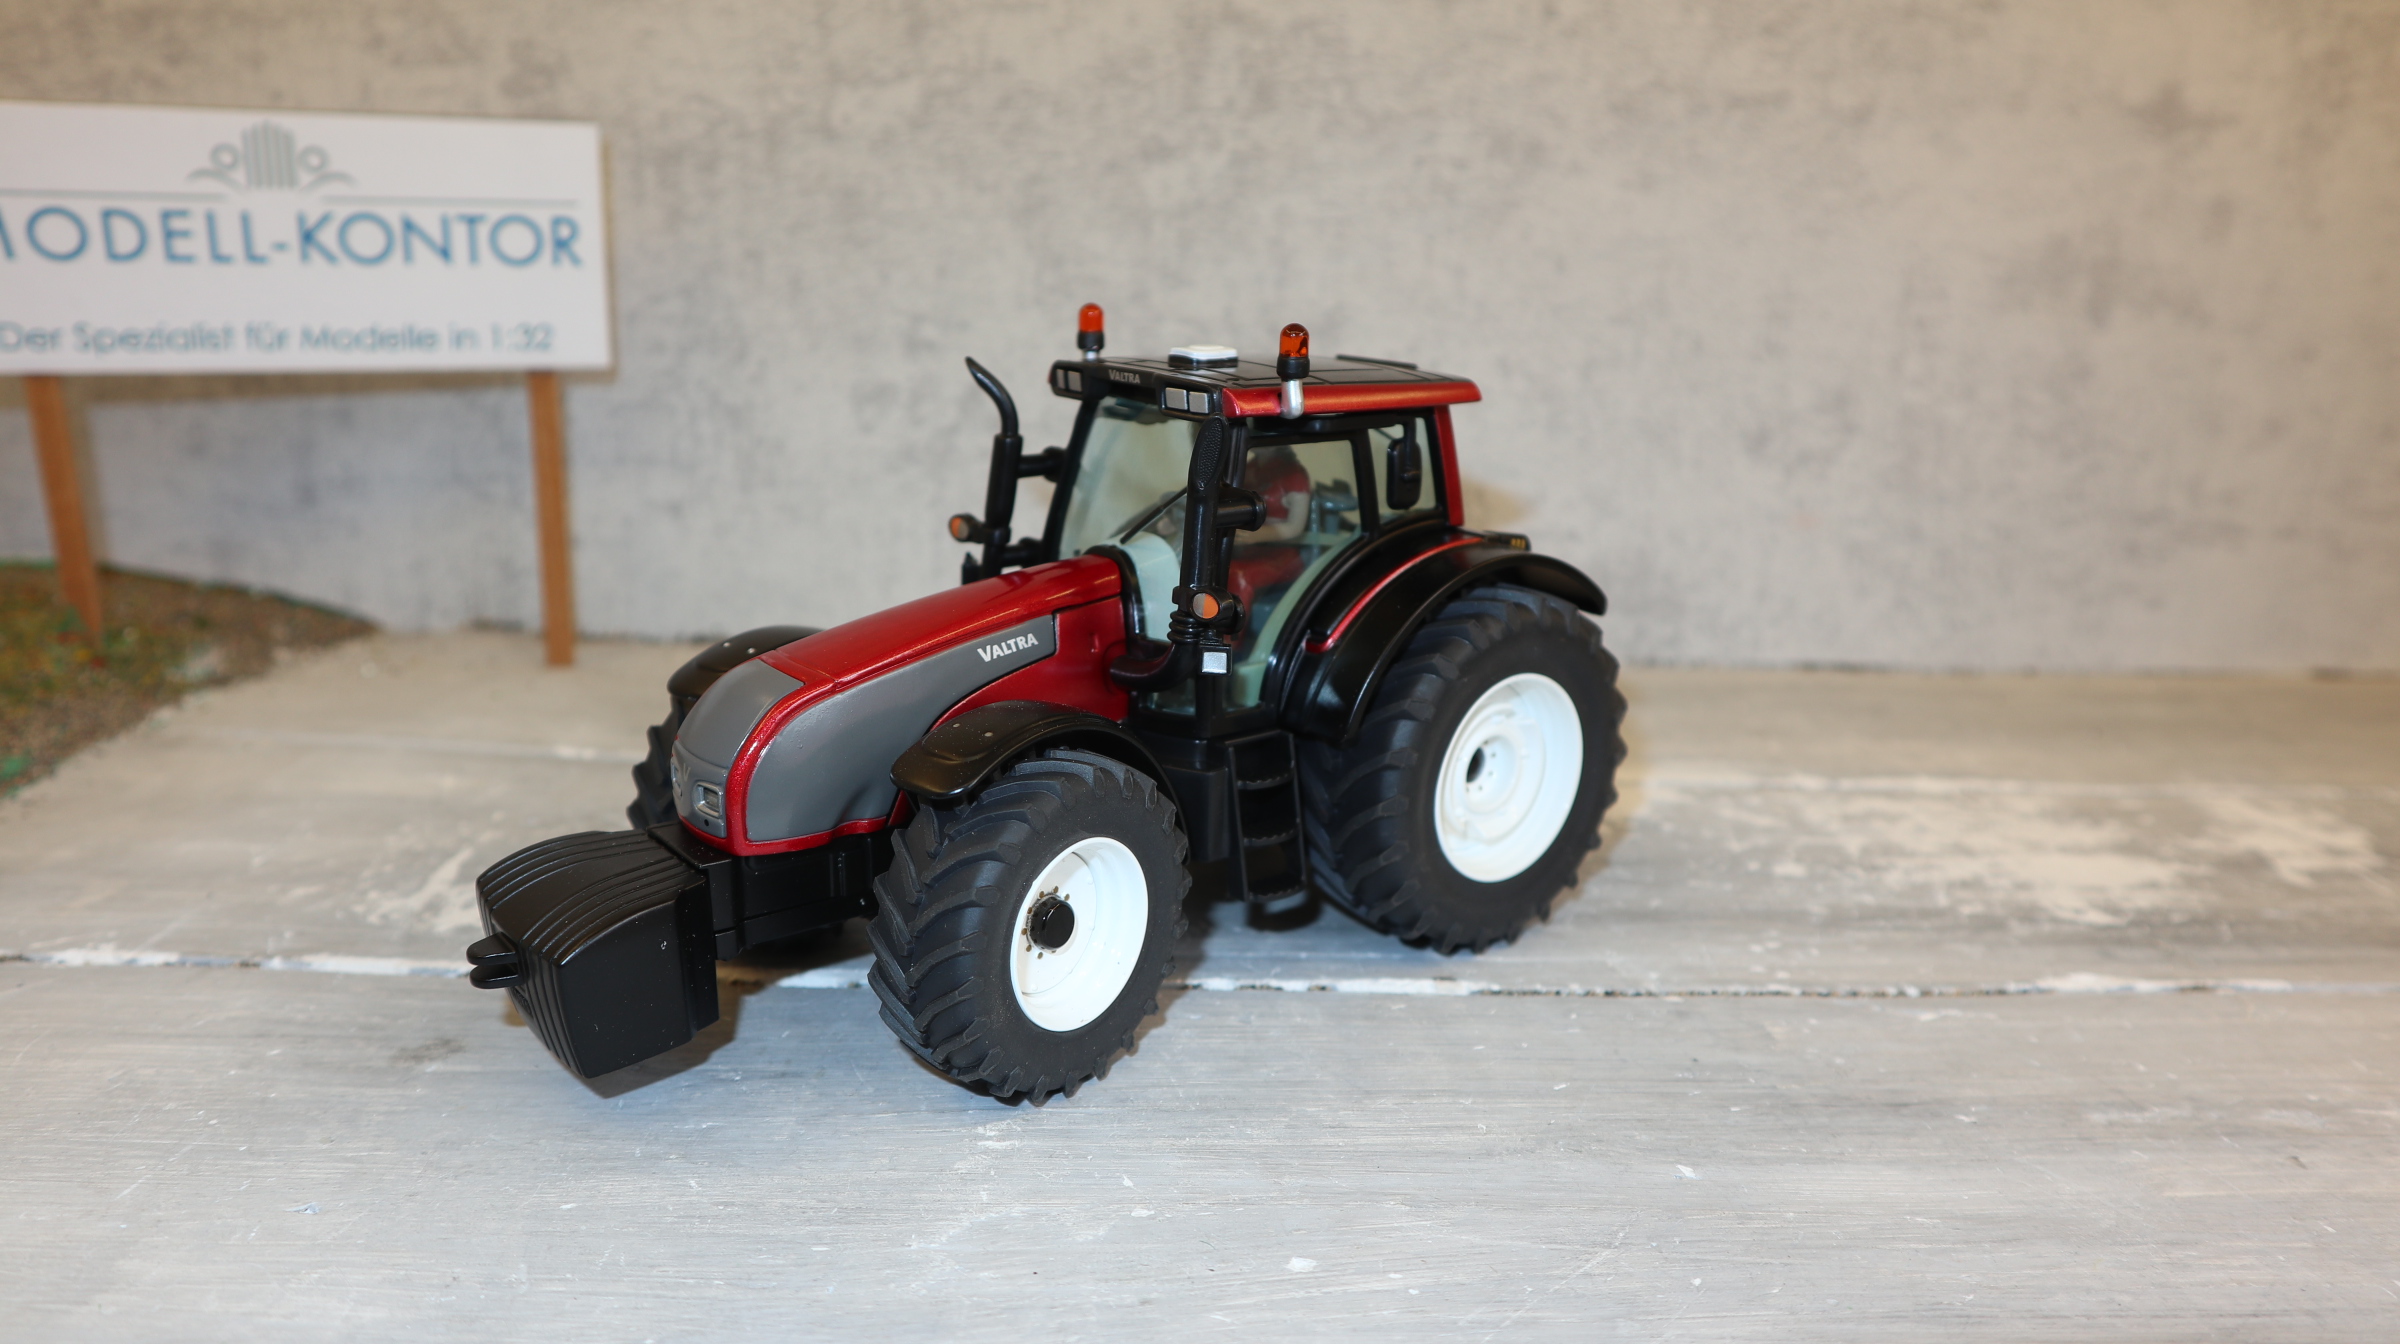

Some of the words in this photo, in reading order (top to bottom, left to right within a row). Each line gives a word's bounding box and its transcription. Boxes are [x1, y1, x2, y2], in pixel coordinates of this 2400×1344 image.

[0, 320, 60, 352] Der
[72, 321, 235, 359] Spezialist
[245, 321, 290, 352] für
[300, 323, 440, 352] Modelle
[450, 324, 480, 351] in
[490, 323, 554, 352] 1:32
[1109, 369, 1140, 383] VALTRA
[977, 633, 1038, 662] VALTRA
